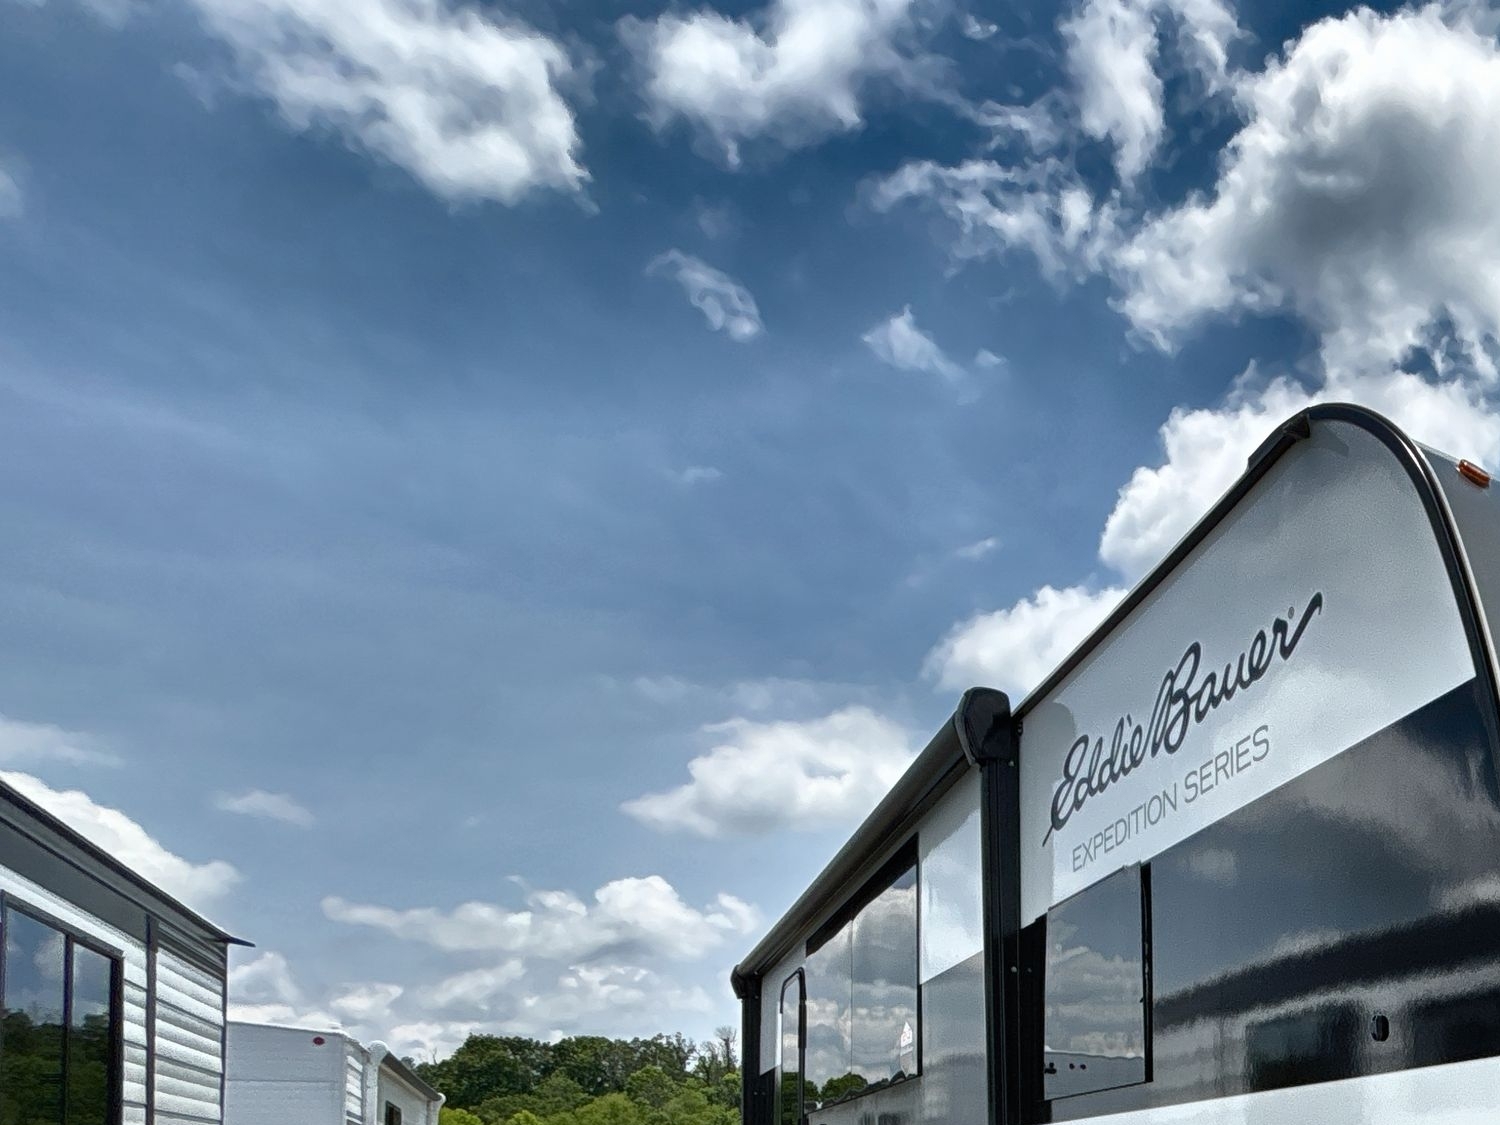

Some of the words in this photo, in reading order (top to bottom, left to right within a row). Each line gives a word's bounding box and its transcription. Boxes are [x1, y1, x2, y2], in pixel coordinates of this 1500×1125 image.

[1042, 713, 1152, 847] Eddie
[1150, 591, 1323, 759] Bauer
[1071, 782, 1178, 873] EXPEDITION
[1183, 724, 1270, 805] SERIES
